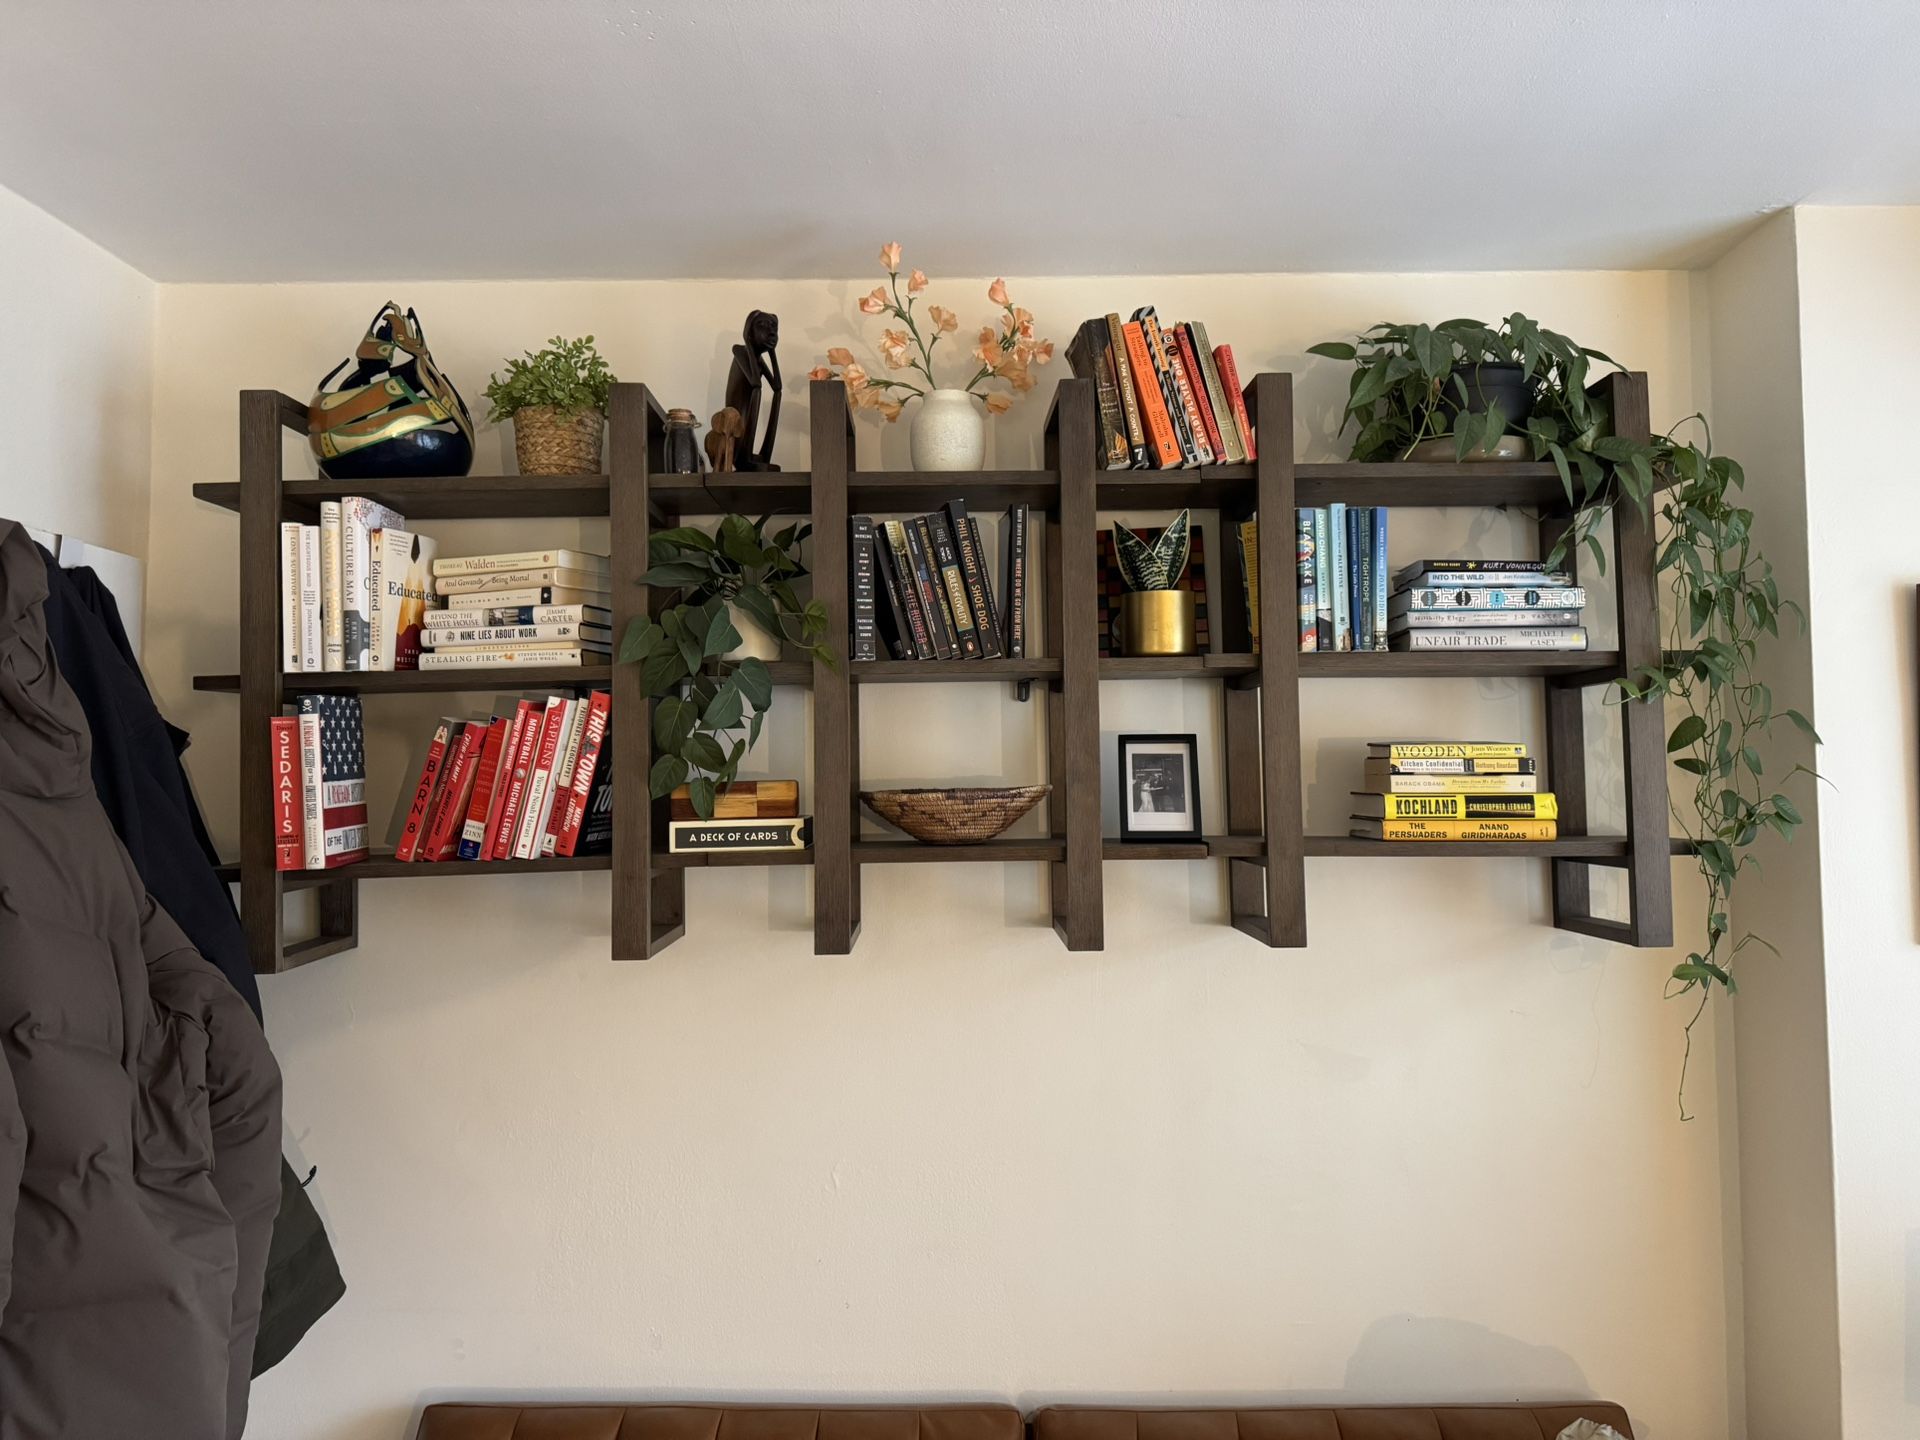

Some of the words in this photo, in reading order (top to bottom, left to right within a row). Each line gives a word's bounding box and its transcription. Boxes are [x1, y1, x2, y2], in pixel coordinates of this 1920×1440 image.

[1131, 336, 1141, 366] Strangers
[1136, 336, 1145, 358] Talking
[1120, 364, 1128, 376] MAN
[1171, 356, 1184, 377] ONE
[1179, 378, 1195, 412] PLAYER
[1191, 415, 1205, 444] READY
[956, 518, 969, 539] PHIL
[345, 526, 354, 577] CULTURE
[962, 540, 977, 574] KNIGHT
[465, 558, 496, 570] Walden
[1304, 556, 1312, 584] CAKE
[1506, 562, 1546, 570] VONNEGUT
[372, 561, 381, 611] Educated
[457, 578, 483, 586] Gawande
[509, 574, 530, 582] Mortal
[1015, 578, 1021, 587] DO
[346, 580, 354, 603] MAP
[388, 581, 438, 602] Educated
[947, 569, 959, 592] RULES
[954, 598, 968, 625] CIVILITY
[971, 584, 985, 609] SHOE
[1015, 588, 1021, 597] WE
[540, 615, 574, 623] CARTER
[546, 608, 567, 616] JIMMY
[977, 610, 990, 631] DOG
[460, 630, 475, 641] NINE
[478, 629, 492, 640] LIES
[495, 628, 516, 639] ABOUT
[518, 627, 538, 638] WORK
[1013, 624, 1021, 640] HERE
[1415, 636, 1460, 646] UNFAIR
[1464, 635, 1507, 646] TRADE
[1520, 630, 1556, 638] MICHAEL
[425, 655, 472, 664] STEALING
[476, 654, 497, 662] FIRE
[574, 706, 586, 738] PRISONERS
[586, 708, 607, 742] THIS
[518, 718, 537, 765] MONEYBALL
[541, 714, 560, 766] SAPIENS
[1395, 745, 1466, 757] WOODEN
[563, 746, 576, 779] GEOGRAPHY
[279, 730, 293, 833] SEDARIS
[573, 753, 597, 796] TOWN
[411, 760, 436, 816] BARN
[506, 781, 522, 817] MICHAEL
[529, 796, 540, 815] Noah
[1396, 799, 1458, 815] KOCHLAND
[563, 797, 577, 833] LEIBOVICH
[571, 806, 582, 828] MARK
[407, 822, 416, 834] 8
[464, 829, 482, 839] ZINN
[499, 817, 512, 844] LEWIS
[689, 833, 697, 842] A
[700, 833, 725, 842] DECK
[727, 832, 741, 841] OF
[744, 831, 778, 841] CARDS
[1479, 823, 1509, 831] ANAND
